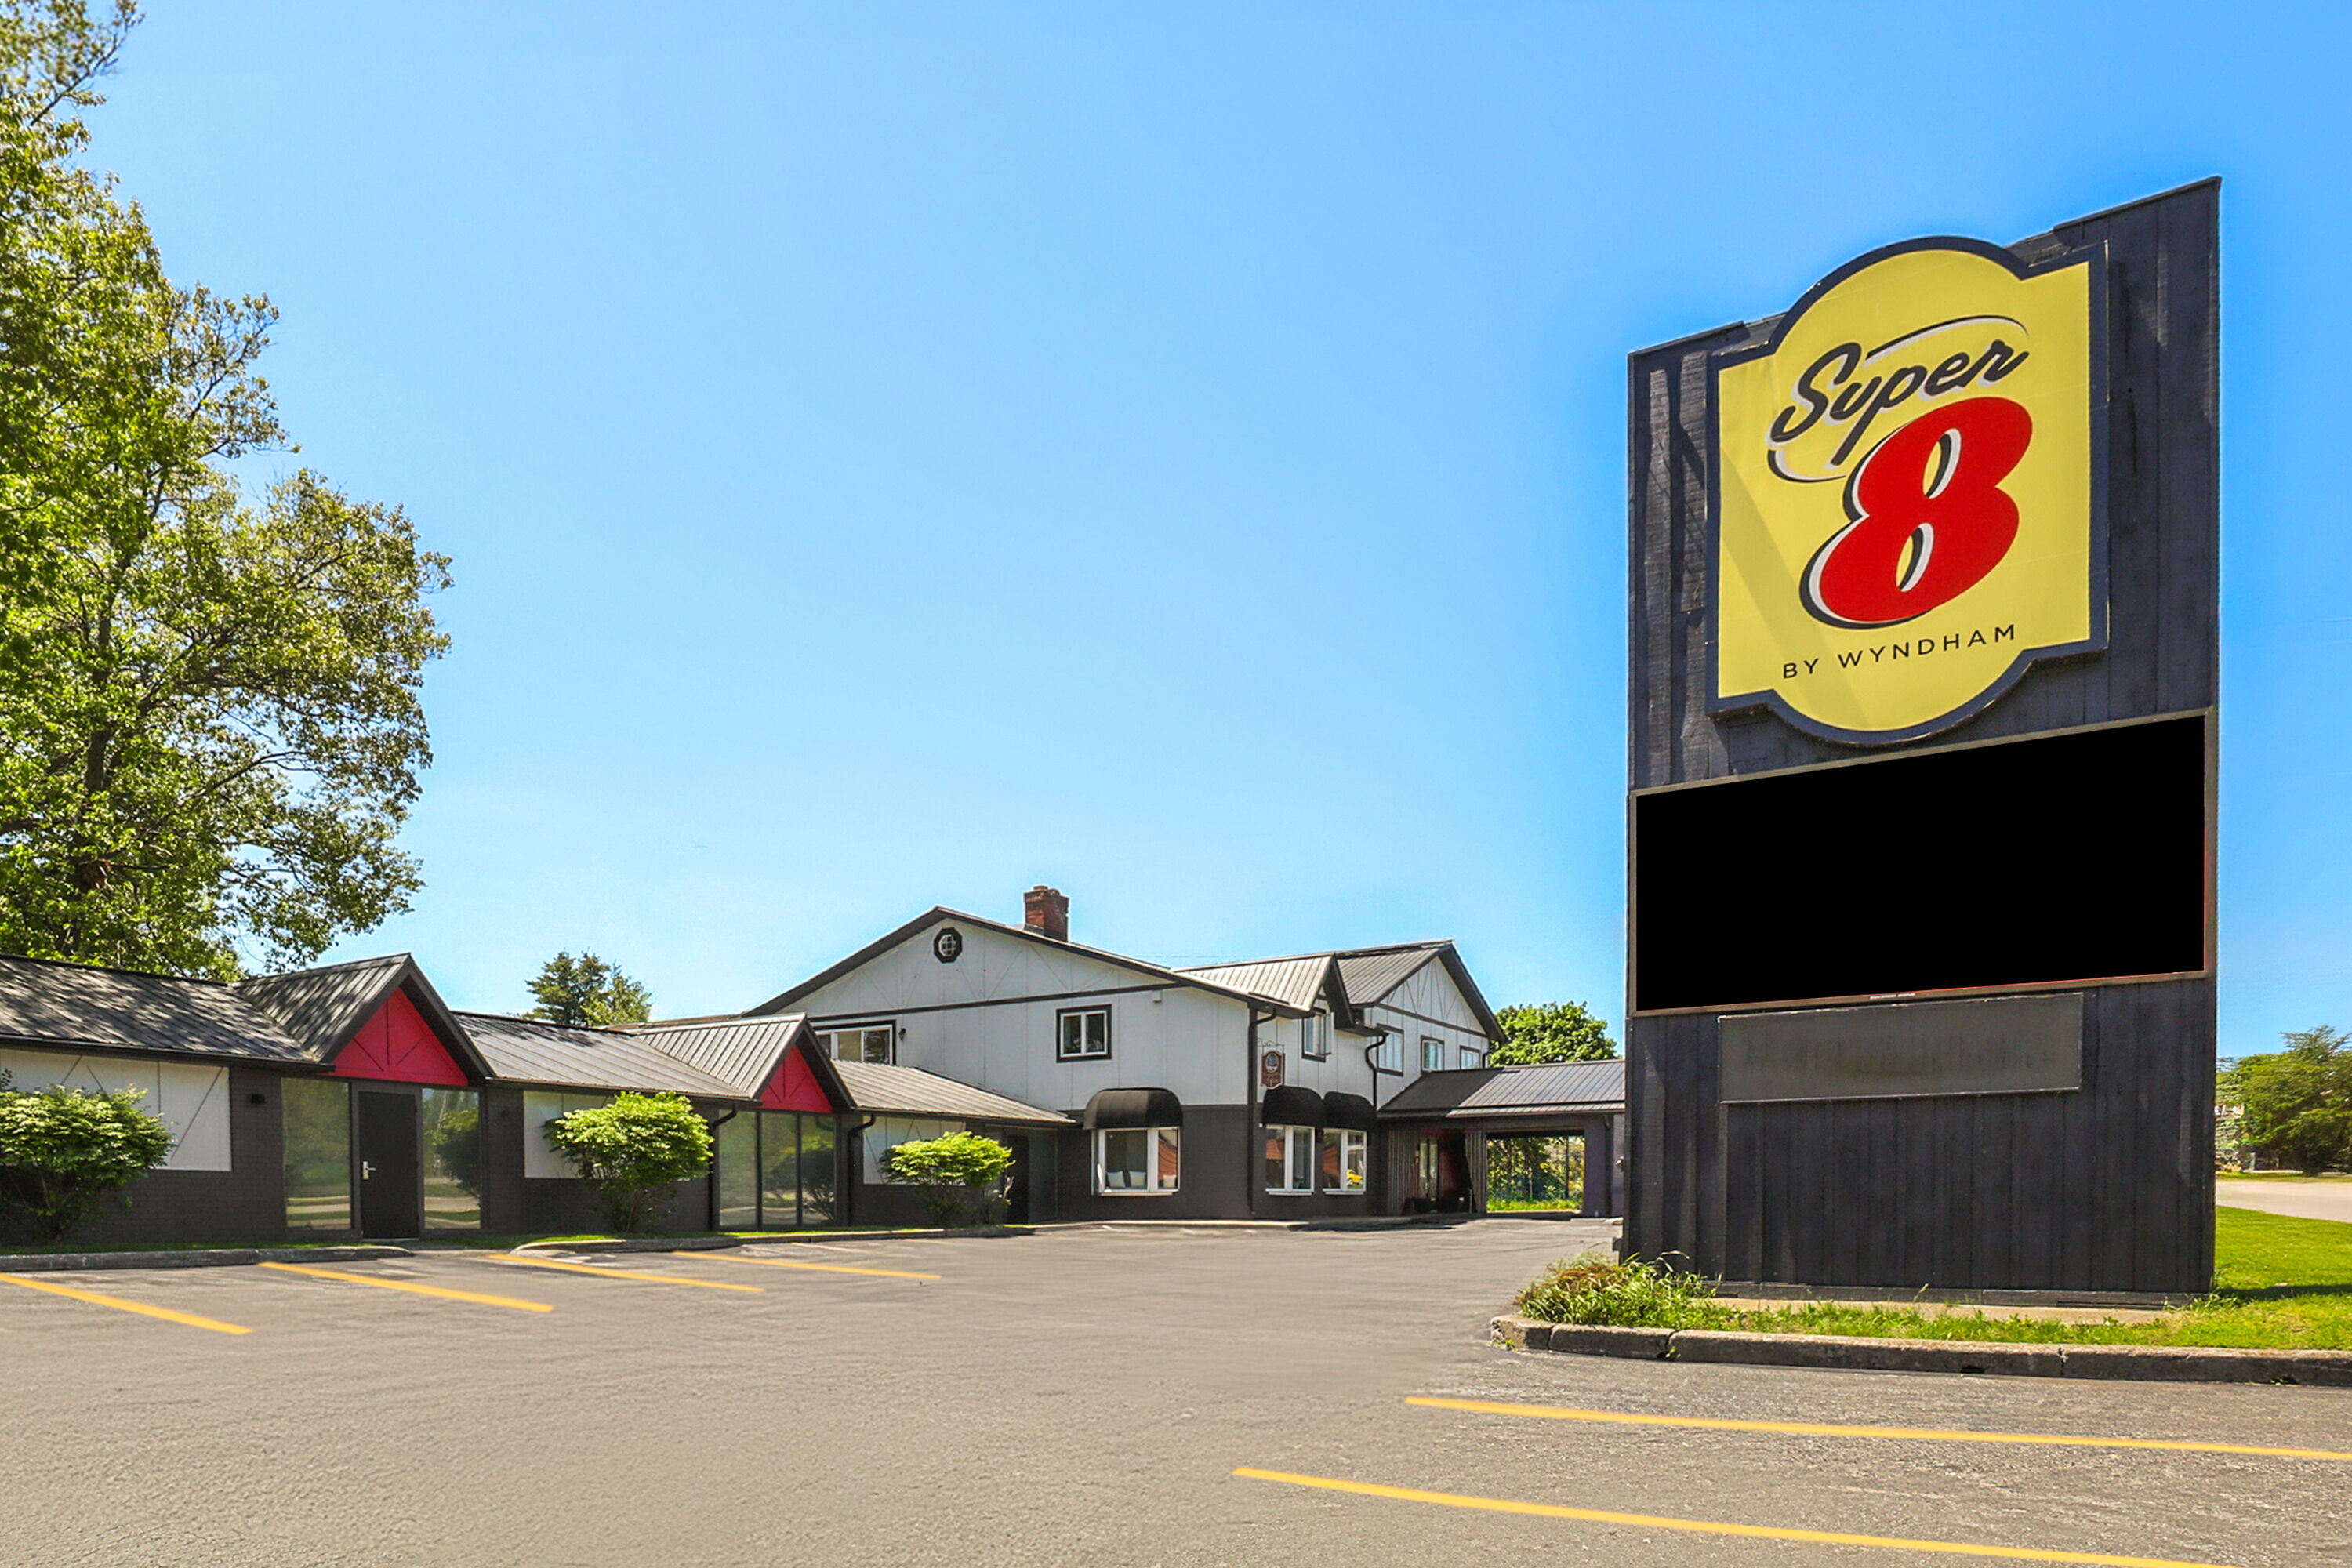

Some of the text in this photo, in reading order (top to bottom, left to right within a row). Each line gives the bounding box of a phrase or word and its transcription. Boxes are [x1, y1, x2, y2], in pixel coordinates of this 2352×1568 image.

[1768, 338, 2029, 470] Super
[1799, 397, 2032, 630] 8
[1783, 624, 2015, 679] BY WYNDHAM
